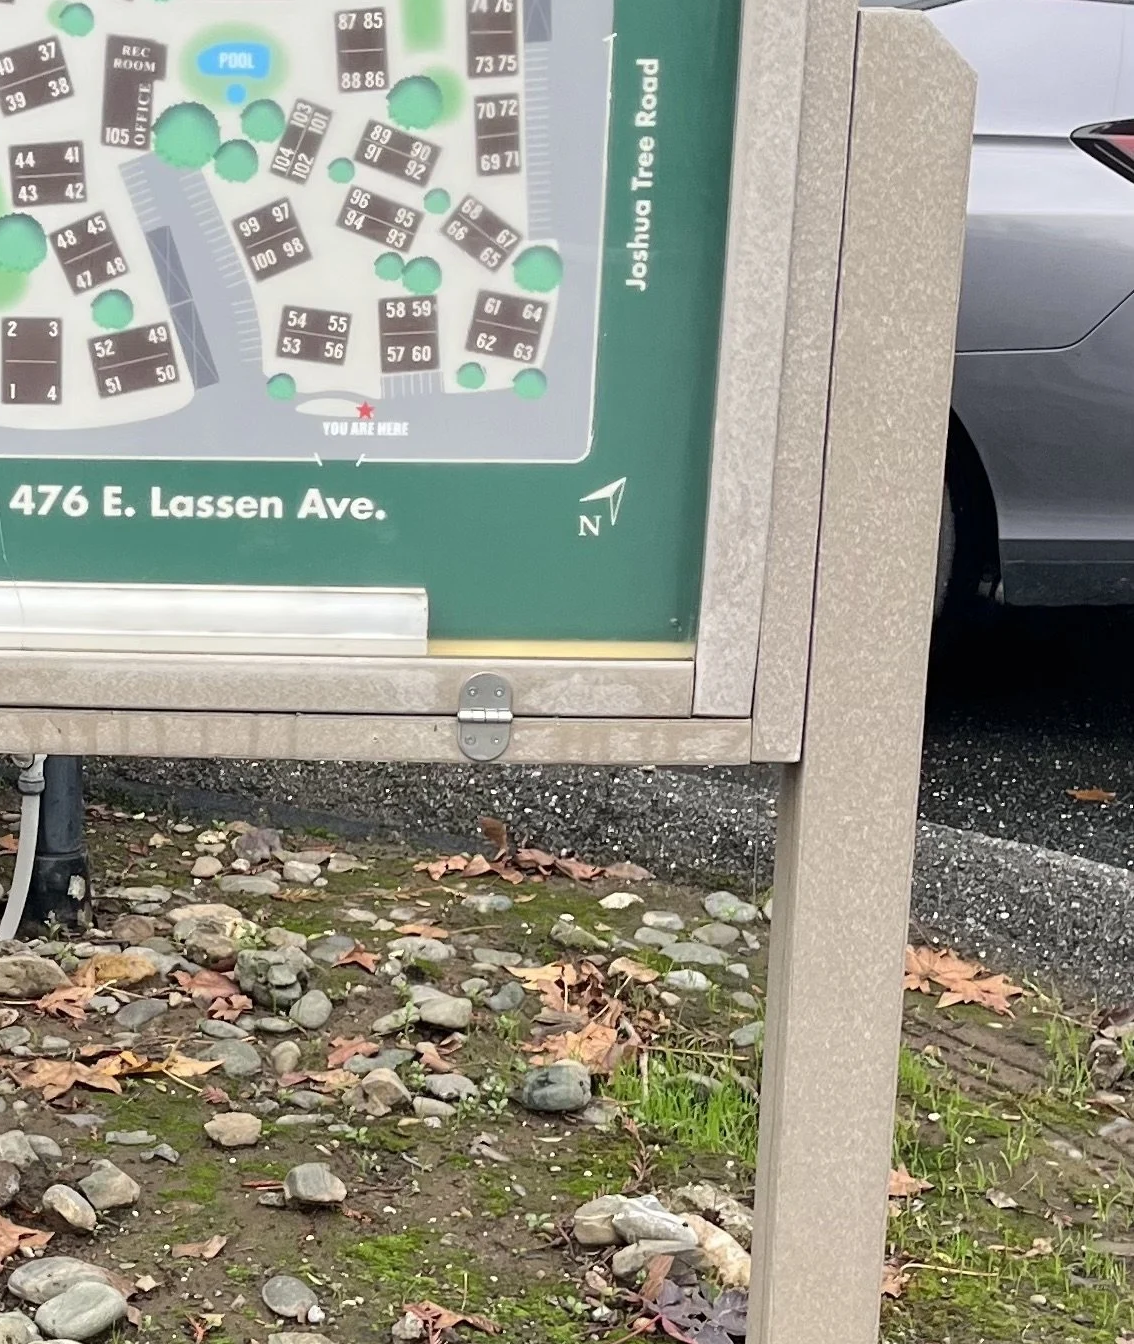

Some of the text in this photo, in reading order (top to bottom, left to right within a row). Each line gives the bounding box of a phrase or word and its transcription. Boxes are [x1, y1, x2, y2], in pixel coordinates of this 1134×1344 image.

[338, 13, 356, 30] 87
[363, 12, 383, 29] 85
[38, 41, 55, 61] 37
[122, 45, 151, 58] REC
[113, 58, 156, 72] ROOM
[219, 52, 254, 69] POOL
[476, 57, 493, 73] 73
[498, 55, 516, 71] 75
[48, 77, 69, 97] 38
[341, 72, 361, 88] 88
[365, 71, 385, 88] 86
[6, 91, 26, 112] 39
[499, 100, 518, 116] 72
[134, 83, 152, 146] OFFICE
[290, 103, 312, 128] 103
[477, 103, 495, 119] 70
[309, 112, 329, 136] 101
[106, 127, 129, 145] 105
[370, 125, 392, 145] 89
[15, 152, 35, 168] 44
[65, 146, 79, 163] 41
[272, 146, 294, 172] 104
[365, 144, 382, 162] 91
[410, 142, 432, 161] 90
[505, 151, 519, 167] 71
[292, 153, 315, 179] 102
[405, 160, 427, 180] 92
[481, 154, 500, 171] 69
[626, 58, 659, 291] Joshua Tree Road
[18, 185, 38, 202] 43
[65, 183, 84, 199] 42
[350, 189, 370, 209] 96
[272, 203, 290, 222] 97
[394, 208, 415, 228] 95
[462, 199, 483, 220] 68
[87, 216, 106, 236] 45
[239, 217, 261, 237] 99
[345, 210, 365, 230] 94
[57, 230, 77, 249] 48
[386, 229, 406, 248] 93
[447, 220, 468, 241] 66
[496, 229, 517, 250] 67
[283, 237, 304, 258] 98
[106, 257, 126, 276] 48
[251, 249, 277, 271] 100
[480, 247, 501, 268] 65
[76, 270, 92, 289] 47
[386, 302, 405, 318] 58
[412, 301, 432, 317] 59
[484, 297, 502, 315] 61
[522, 304, 543, 322] 64
[287, 311, 307, 328] 54
[328, 315, 348, 333] 55
[8, 321, 17, 337] 2
[49, 322, 58, 337] 3
[148, 326, 167, 344] 49
[94, 339, 115, 358] 52
[282, 337, 301, 354] 53
[324, 342, 344, 359] 56
[476, 333, 497, 351] 62
[387, 347, 405, 363] 57
[412, 346, 431, 362] 60
[513, 342, 533, 361] 63
[156, 365, 176, 383] 50
[10, 384, 15, 399] 1
[47, 386, 56, 400] 4
[105, 377, 122, 393] 51
[323, 422, 409, 436] YOU ARE HERE
[9, 485, 386, 520] 476 E. Lassen Ave.
[578, 515, 602, 536] N
